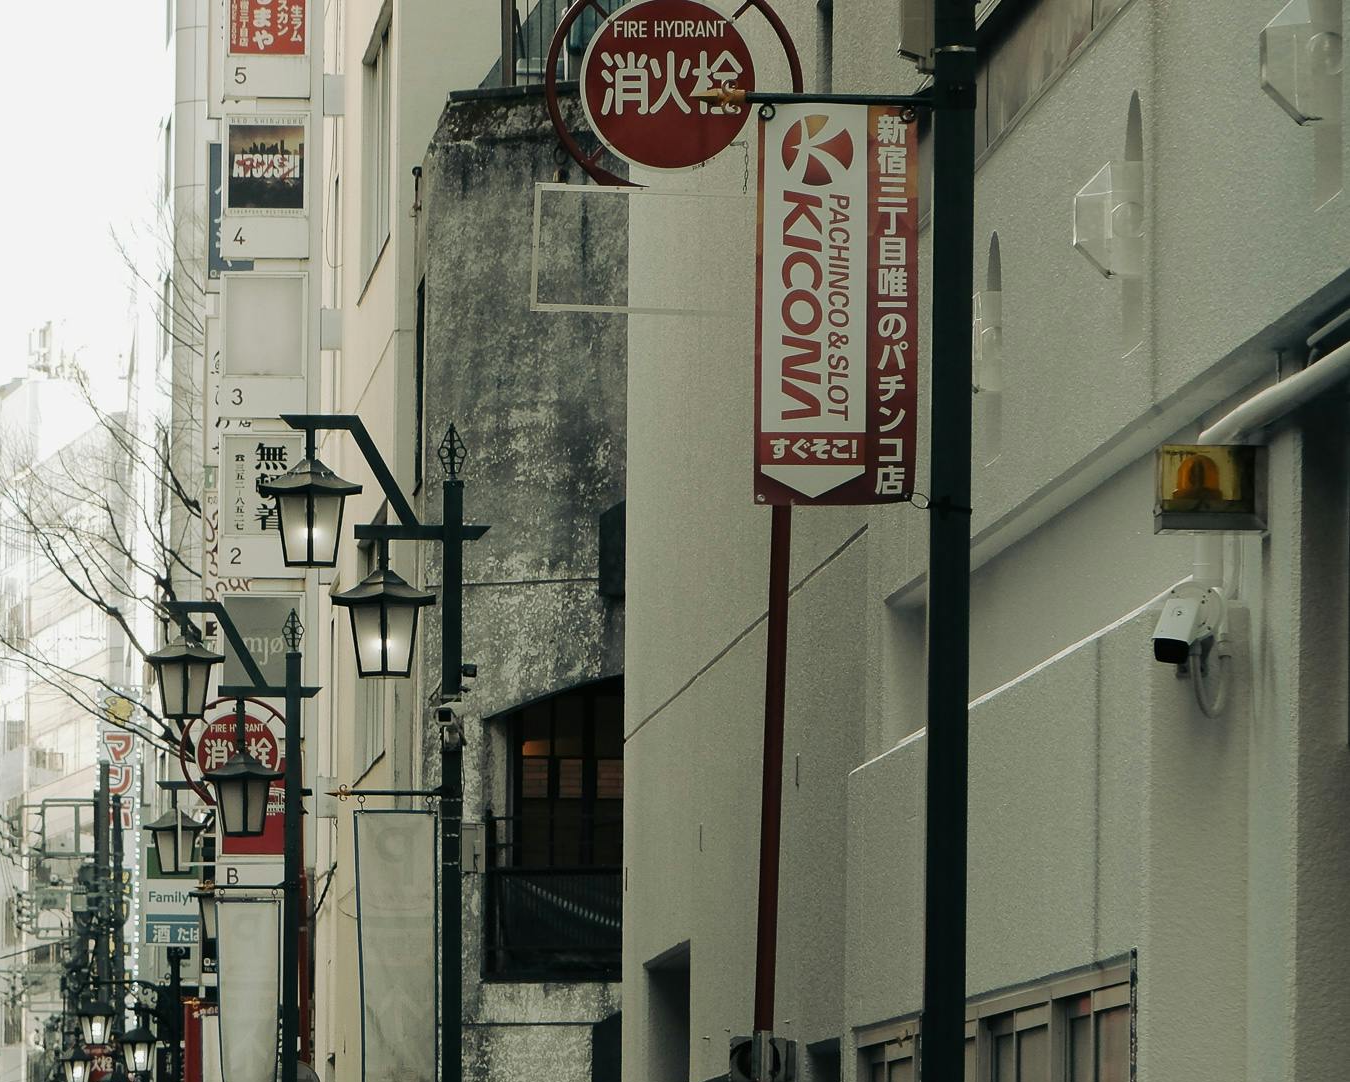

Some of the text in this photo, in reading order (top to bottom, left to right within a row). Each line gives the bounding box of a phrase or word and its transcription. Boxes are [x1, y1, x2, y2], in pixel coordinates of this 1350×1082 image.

[613, 20, 727, 38] FIRE HYDRANT
[234, 67, 247, 84] 5
[600, 50, 744, 116] 消火栓
[232, 227, 246, 245] 4
[827, 194, 851, 327] PACHINCO
[781, 189, 823, 421] KICONA
[874, 113, 908, 496] 新宿三丁目唯一のパチンコ店
[231, 388, 243, 405] 3
[826, 354, 850, 422] SLOT
[769, 437, 858, 460] すぐそこ!
[230, 547, 242, 565] 2
[210, 723, 265, 734] FIRE HYRANT
[205, 738, 273, 770] 消栓
[103, 731, 135, 830] マン
[227, 868, 239, 884] B
[152, 925, 171, 943] 酒
[91, 1055, 114, 1073] 火栓
